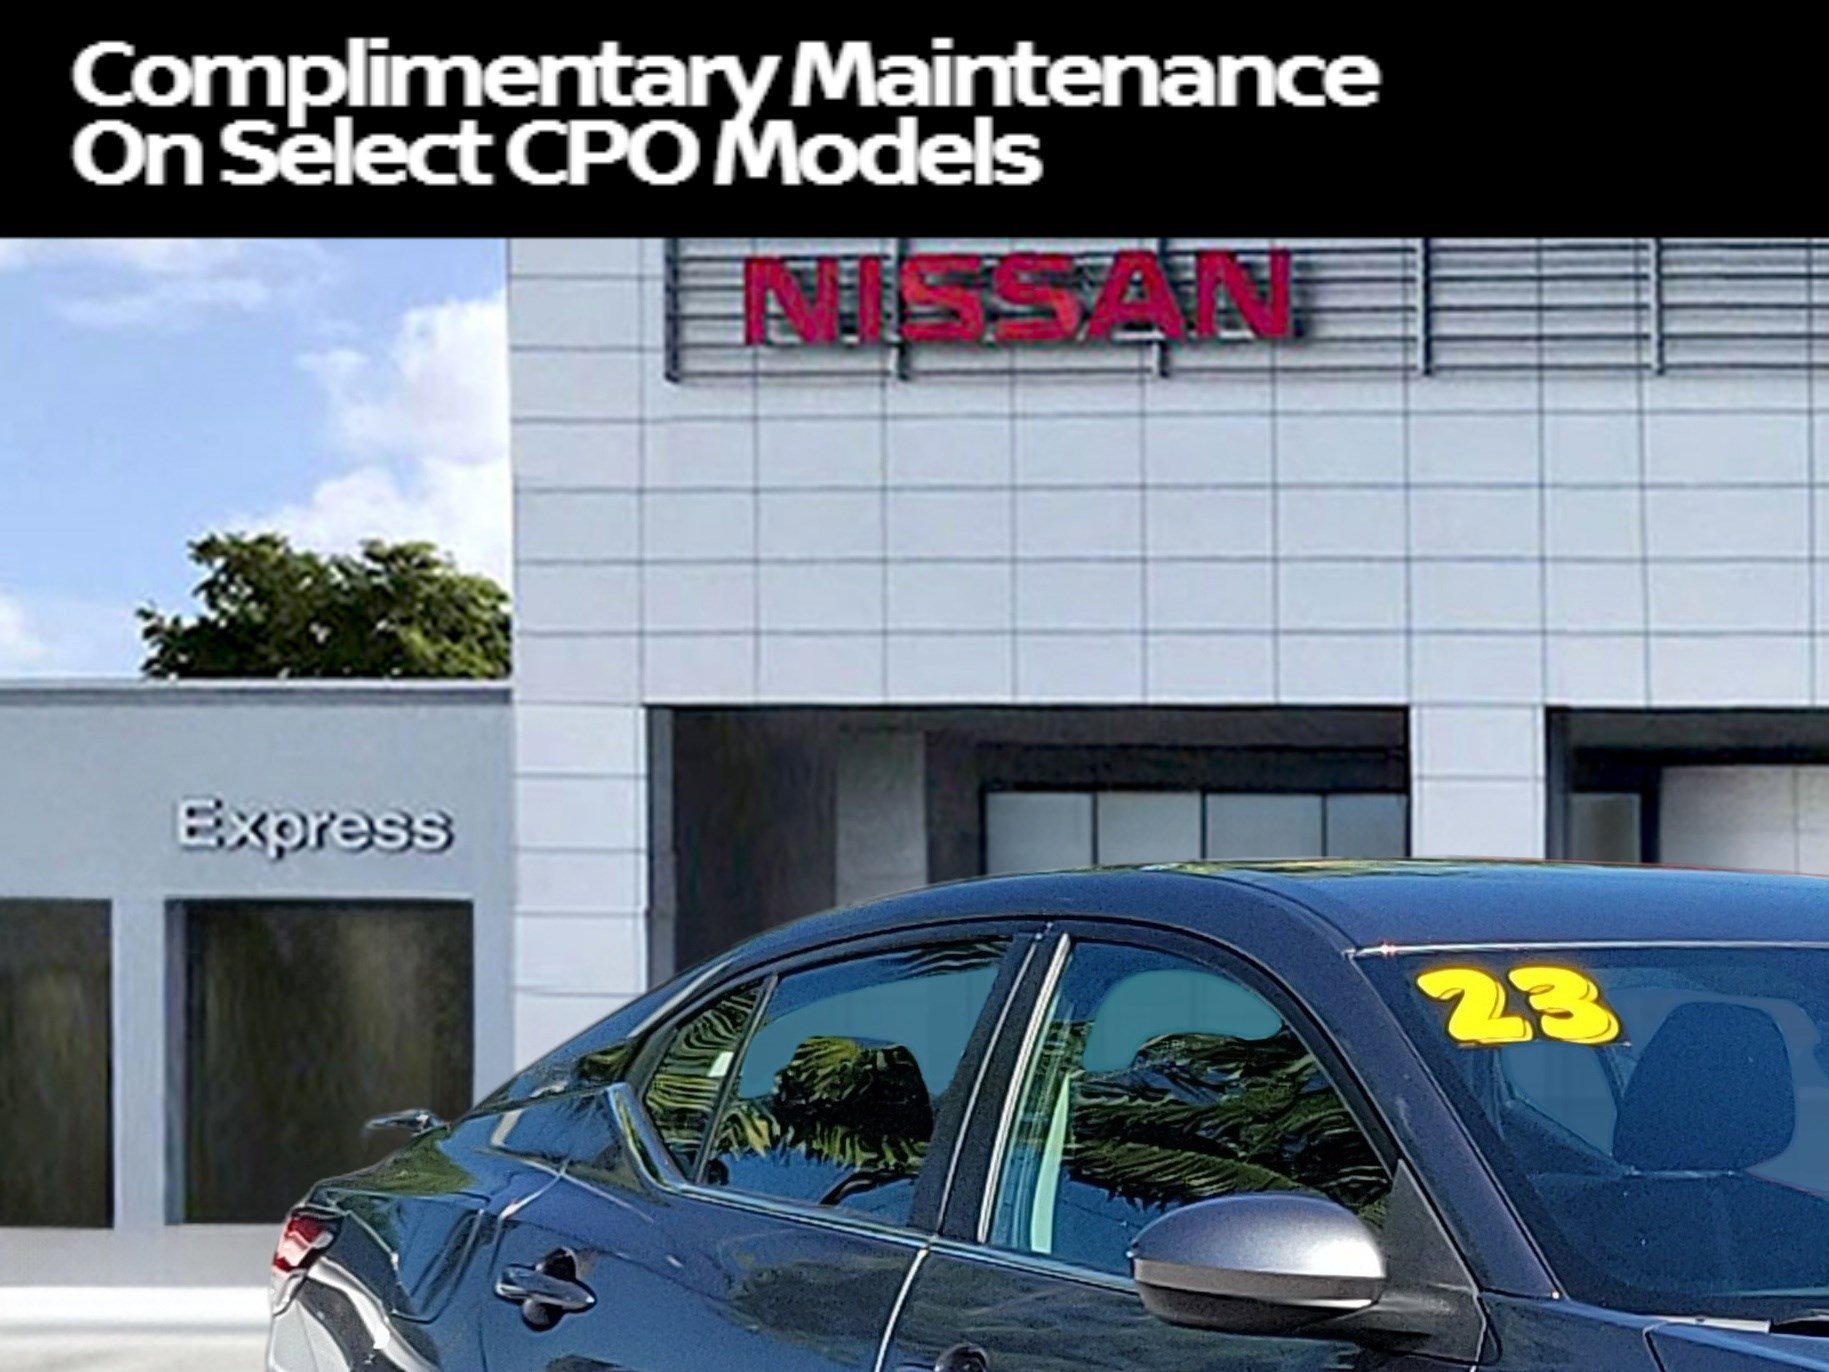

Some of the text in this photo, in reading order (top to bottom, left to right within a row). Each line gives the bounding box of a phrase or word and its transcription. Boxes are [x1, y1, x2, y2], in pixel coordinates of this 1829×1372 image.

[744, 249, 1293, 345] NISSAN
[177, 797, 454, 860] Express
[1416, 965, 1621, 1045] 23
